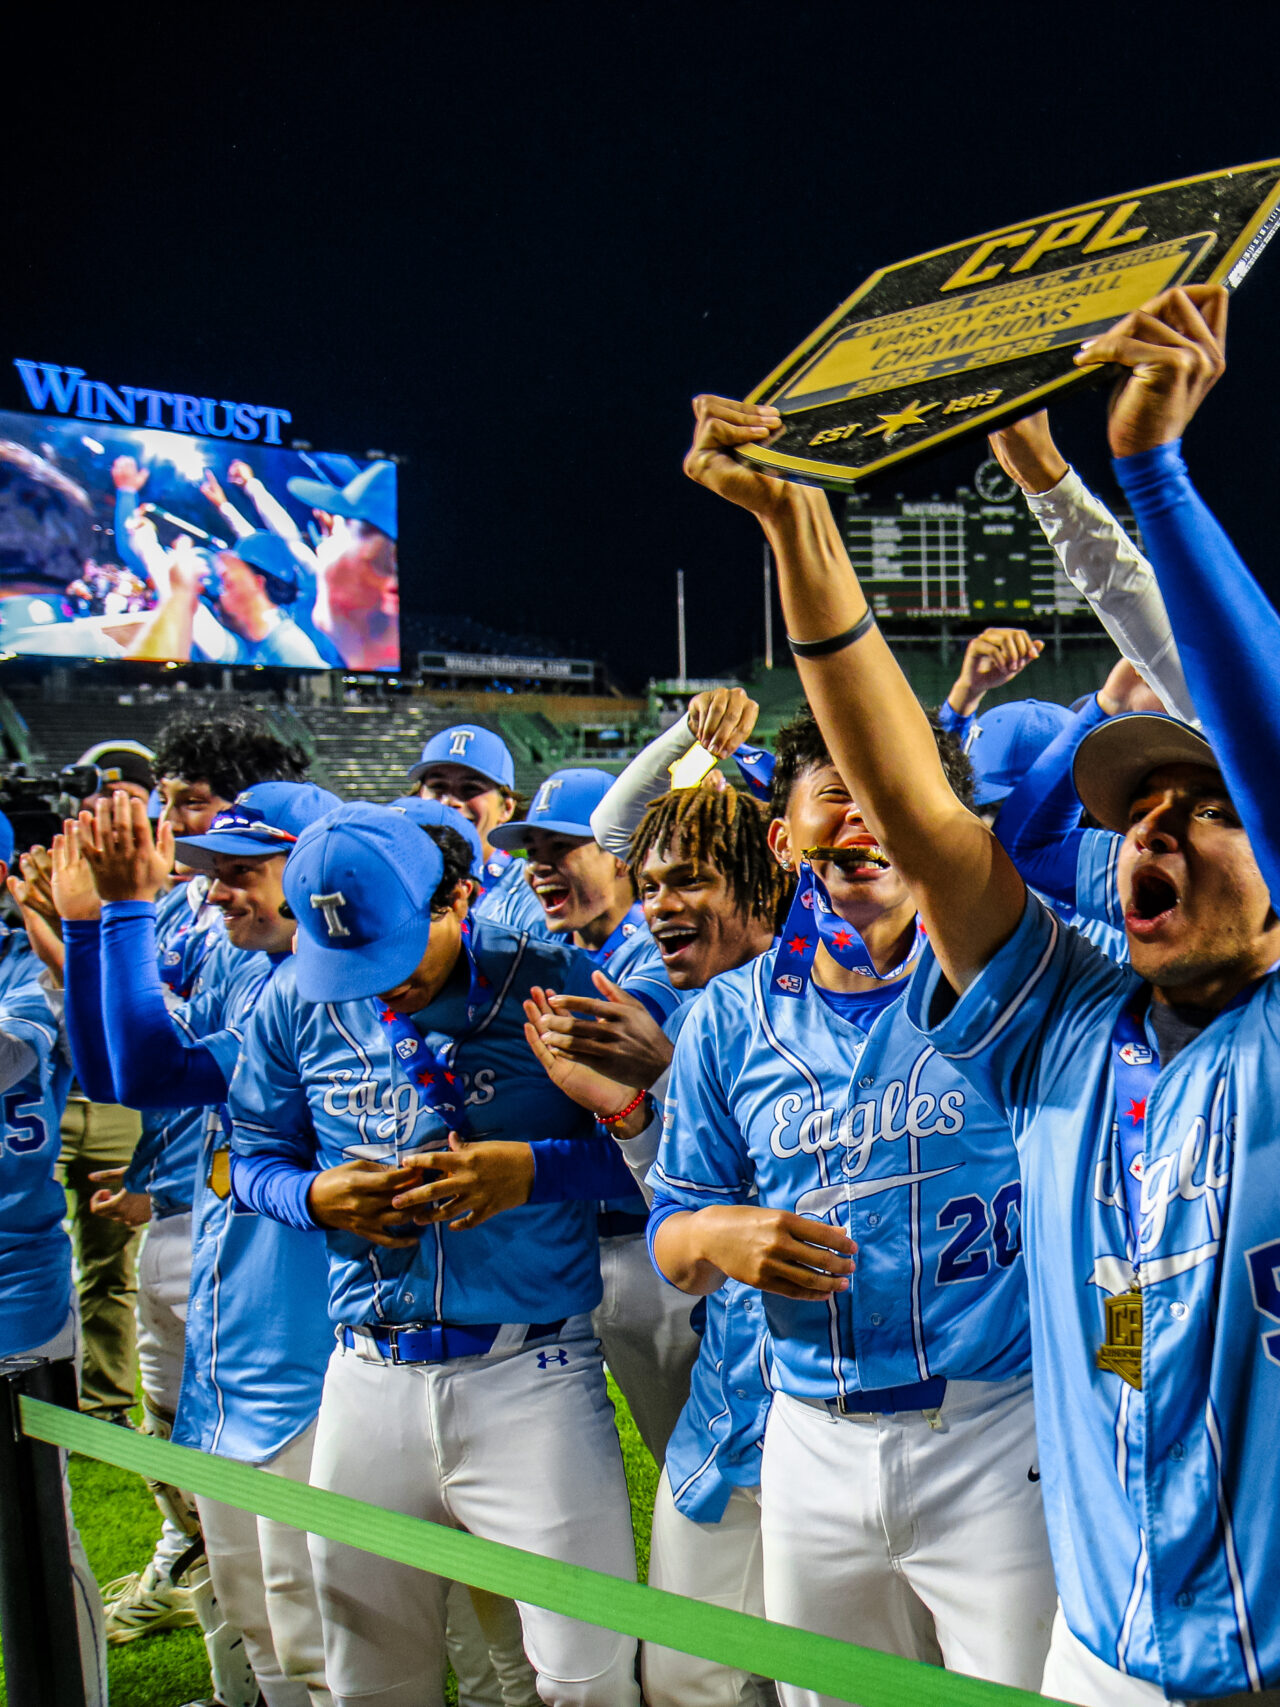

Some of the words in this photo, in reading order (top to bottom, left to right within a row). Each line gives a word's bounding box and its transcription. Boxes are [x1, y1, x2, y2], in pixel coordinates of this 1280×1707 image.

[939, 200, 1149, 292] CPL
[869, 310, 982, 350] VARSITY
[982, 274, 1123, 322] BASEBALL
[870, 303, 1081, 371] CHAMPIONS
[846, 363, 935, 397] 2025
[965, 334, 1056, 369] 2026
[13, 358, 292, 446] WINTRUST
[808, 423, 863, 447] EST
[942, 388, 1004, 415] 1913
[449, 730, 475, 756] T
[535, 779, 564, 812] T
[309, 891, 351, 937] T
[0, 1091, 49, 1156] 5
[323, 1068, 496, 1145] Eags
[768, 1080, 965, 1177] Eagles
[934, 1180, 1022, 1287] 20
